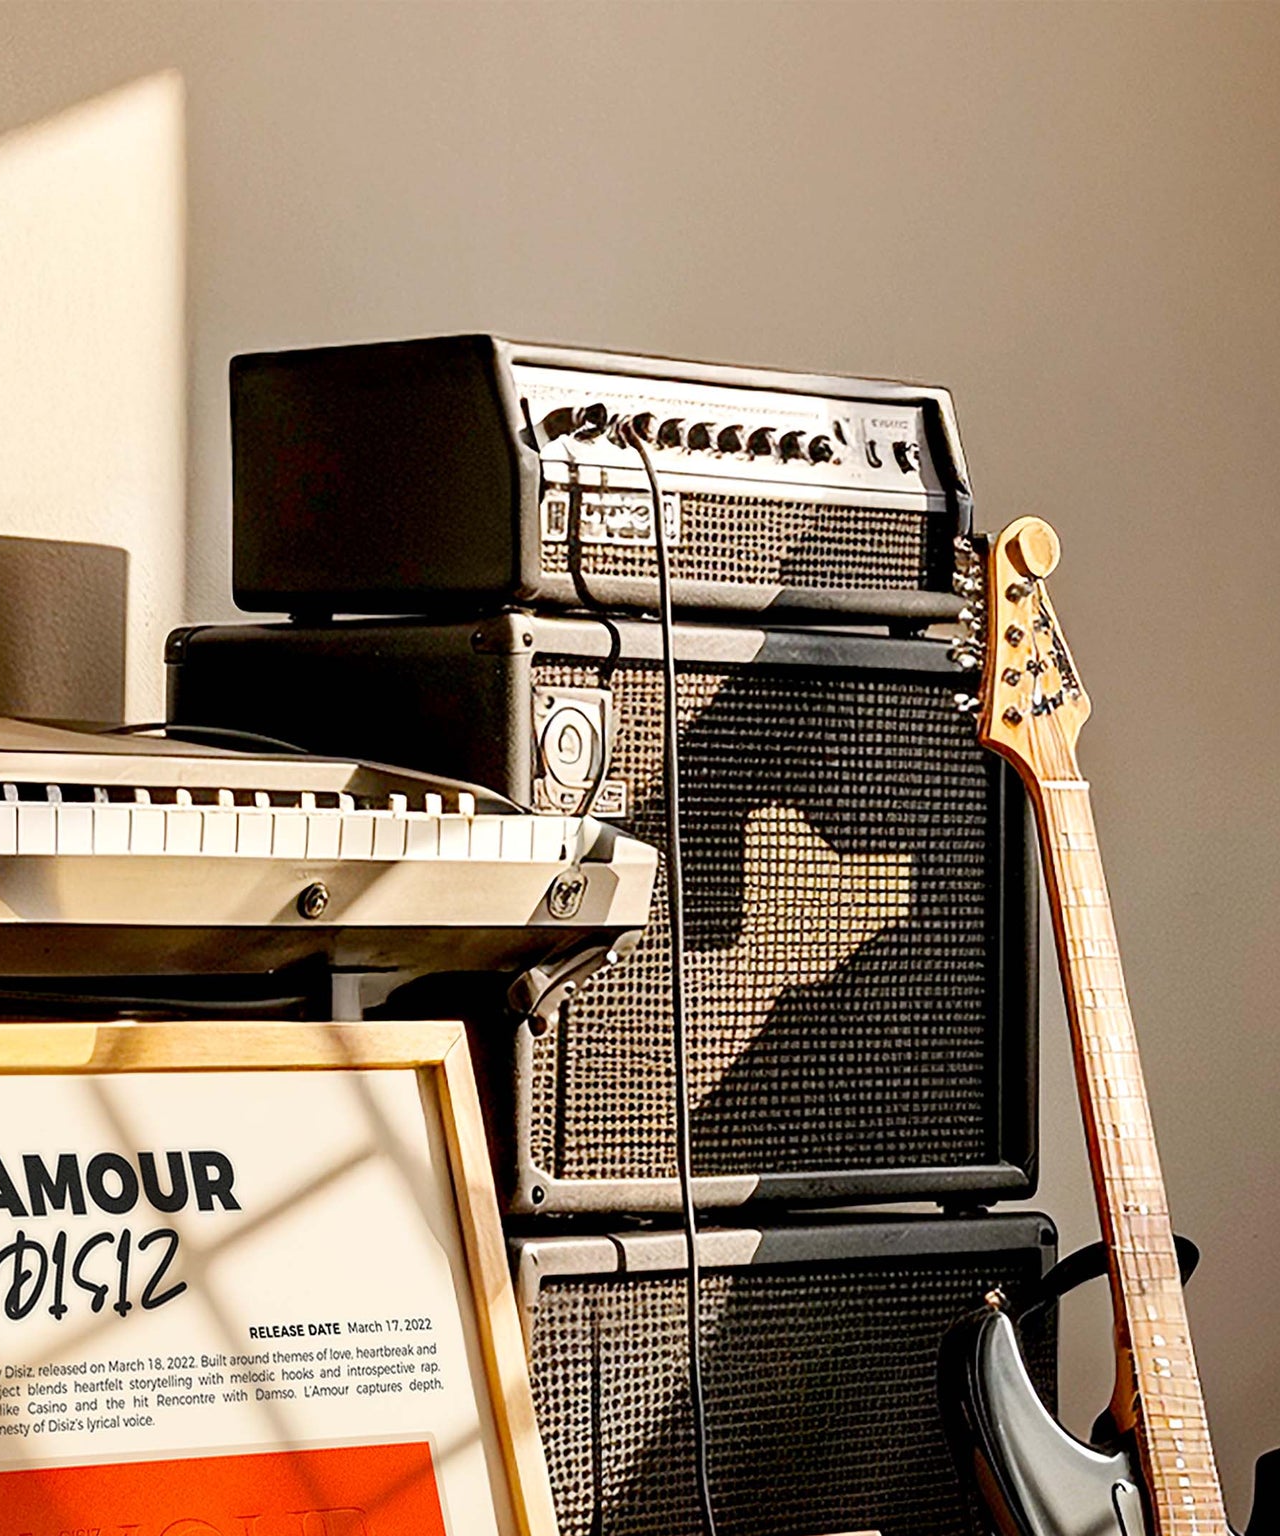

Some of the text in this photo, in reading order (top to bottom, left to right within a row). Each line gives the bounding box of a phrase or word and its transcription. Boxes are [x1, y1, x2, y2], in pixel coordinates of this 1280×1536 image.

[249, 1318, 432, 1339] RELEASE DATE March 17, 2022
[32, 1418, 45, 1434] of
[48, 1418, 84, 1433] Disiz's
[86, 1415, 120, 1433] lyrical
